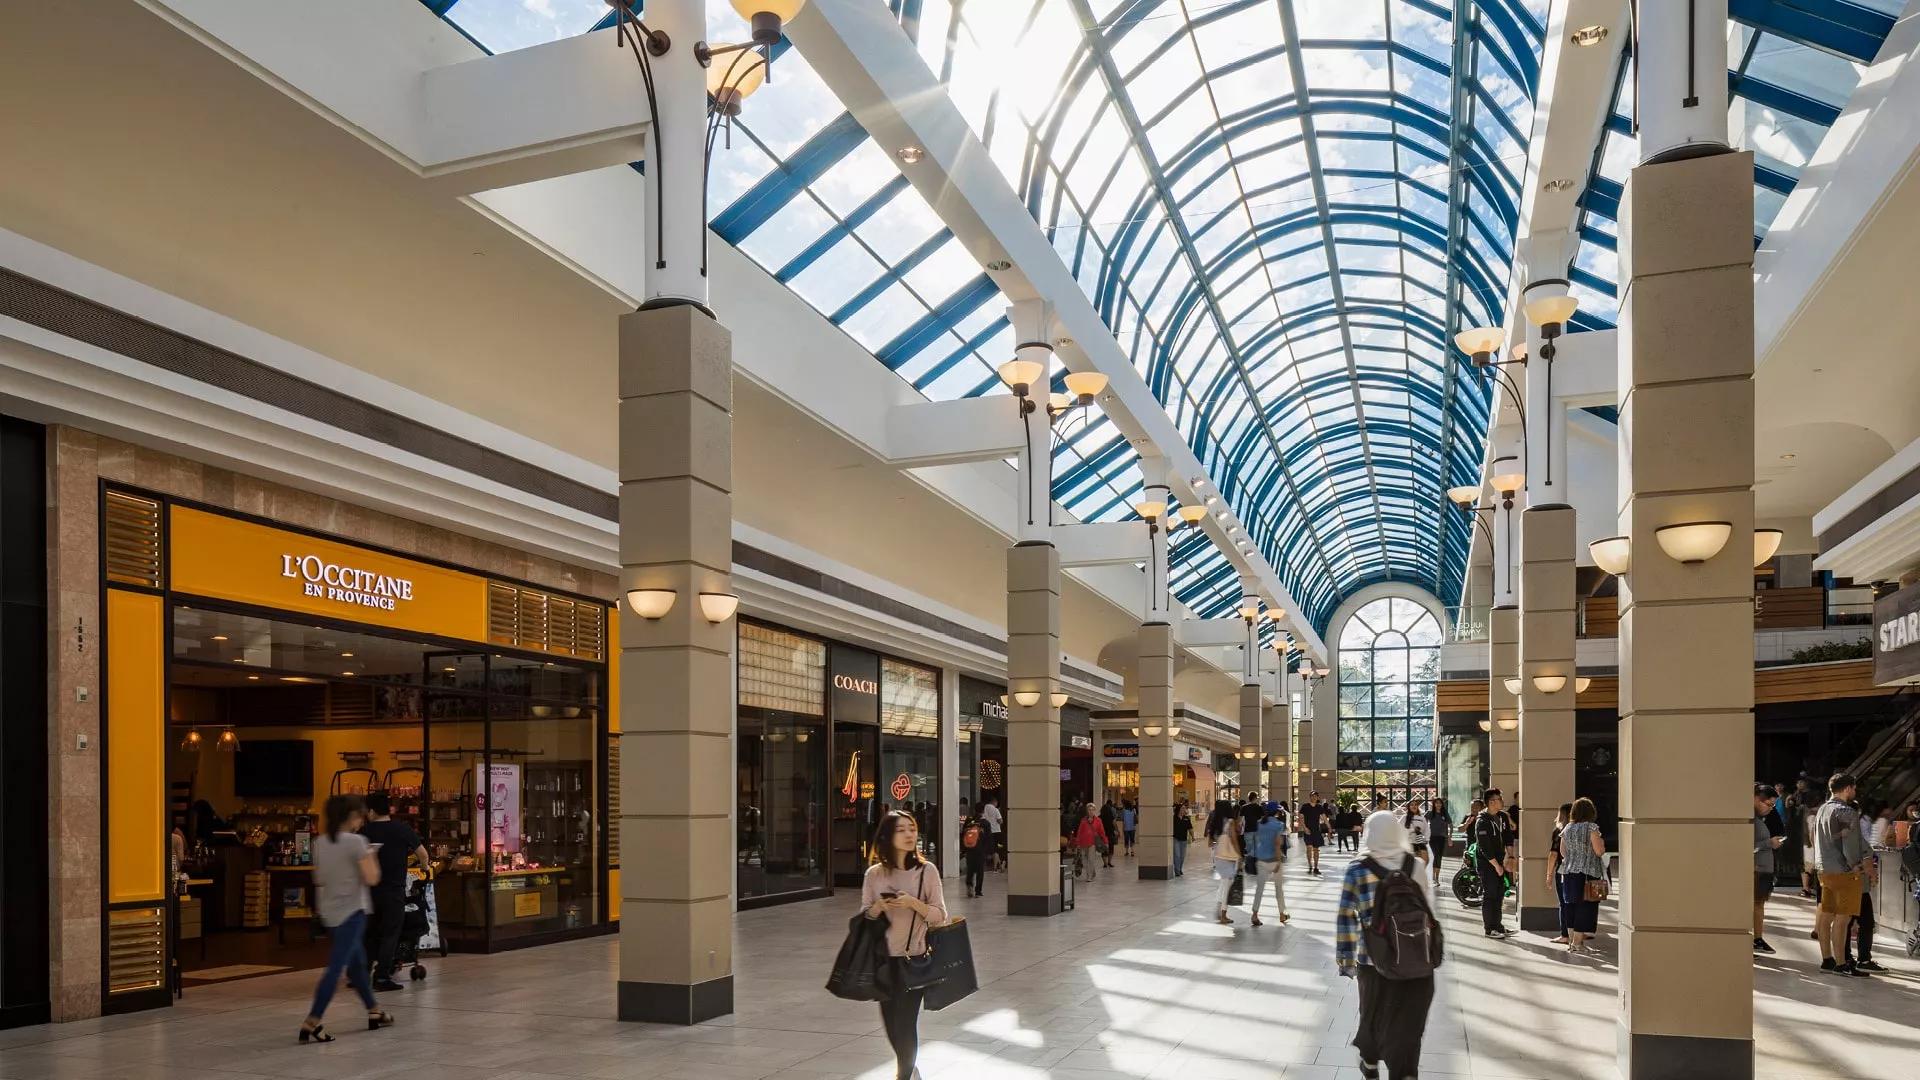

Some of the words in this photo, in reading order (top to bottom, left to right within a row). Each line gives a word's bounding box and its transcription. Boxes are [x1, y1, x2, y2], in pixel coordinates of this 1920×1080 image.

[282, 554, 413, 600] L'OCCITANE
[304, 582, 323, 598] EN
[328, 587, 395, 611] PROVENCE
[834, 674, 878, 695] COACH
